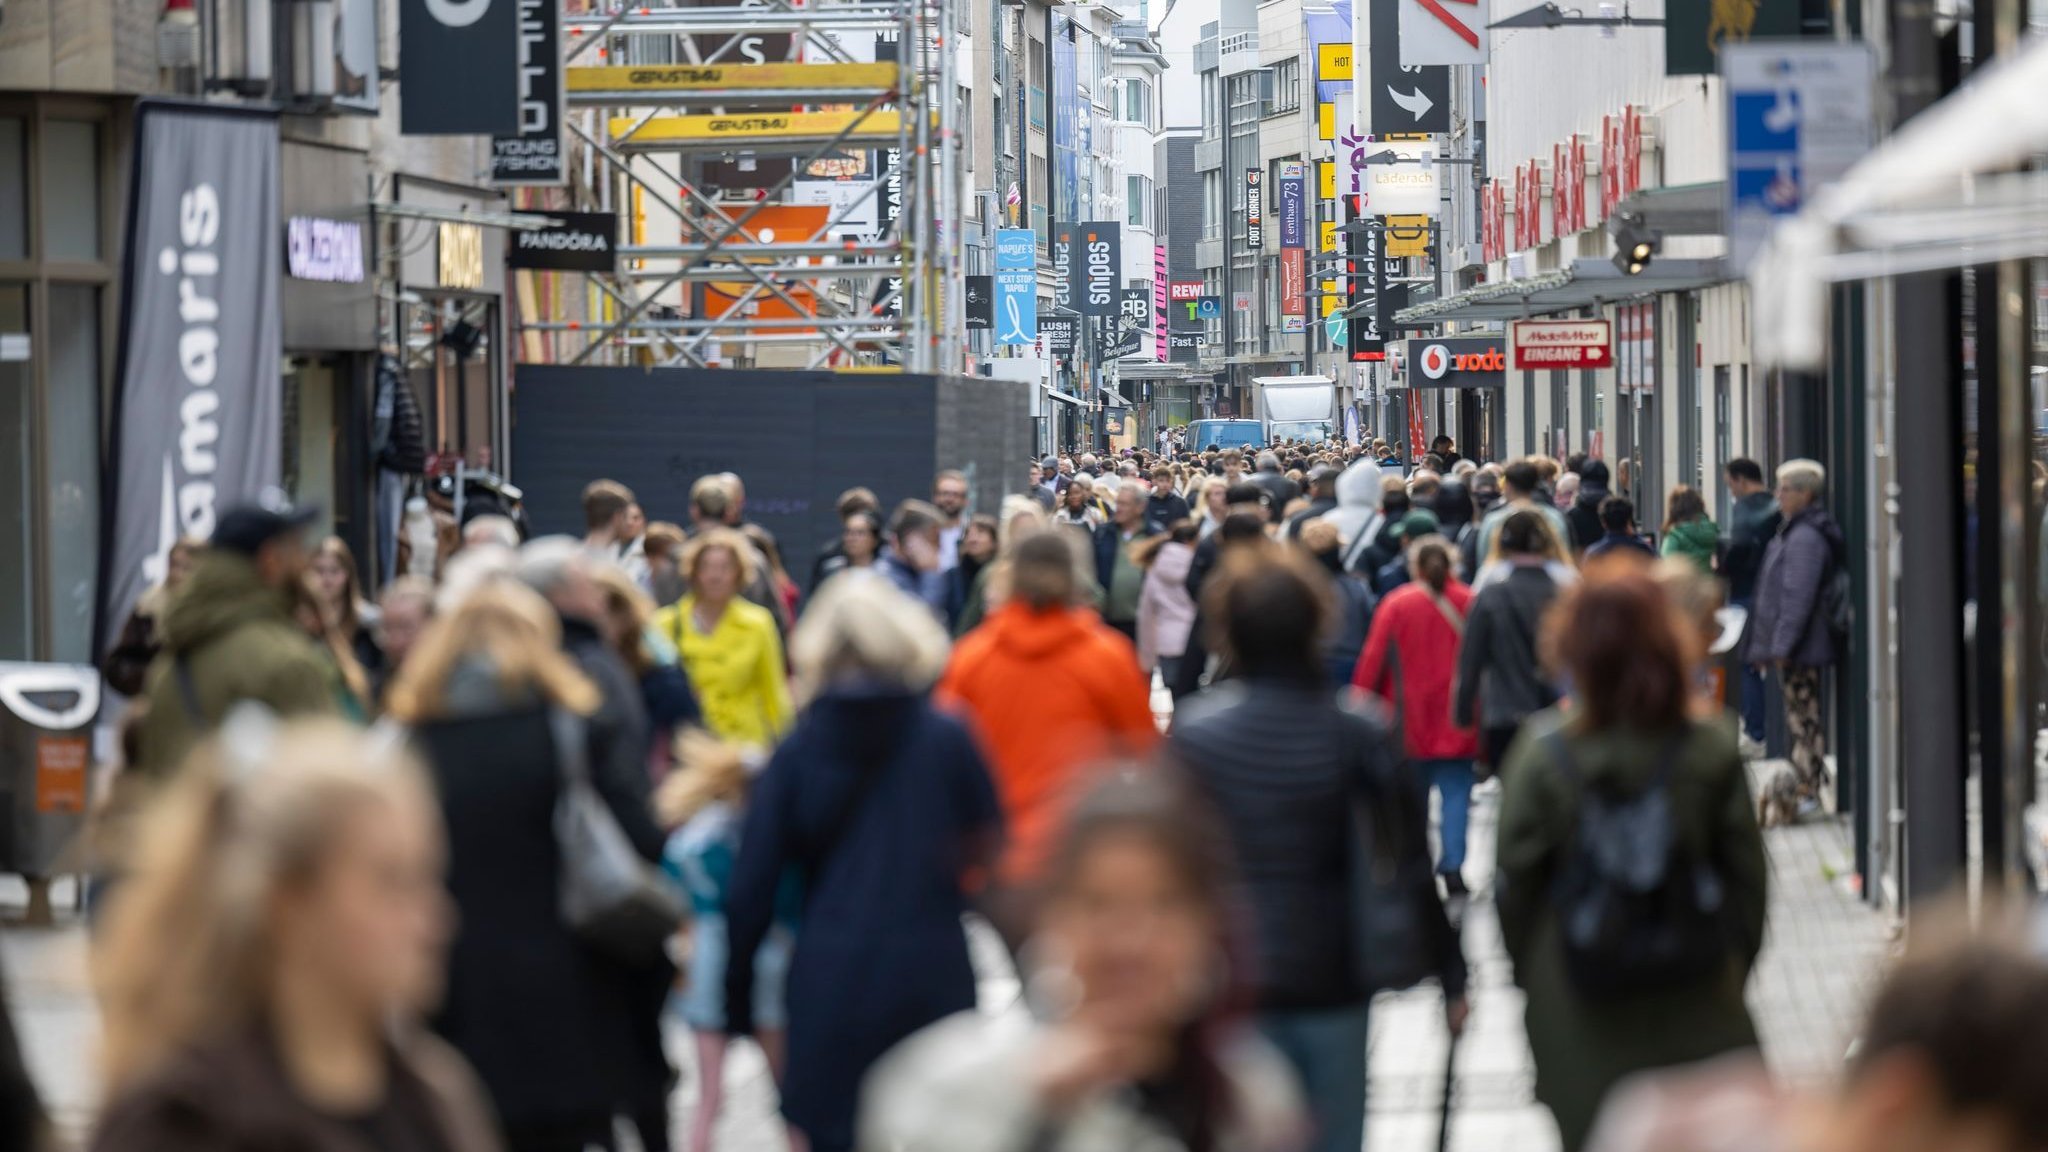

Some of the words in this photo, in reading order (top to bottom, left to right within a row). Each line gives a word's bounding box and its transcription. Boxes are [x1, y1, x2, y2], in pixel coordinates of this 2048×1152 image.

[1334, 57, 1350, 67] HOT
[495, 139, 556, 155] YOUNG
[1375, 172, 1433, 184] Läderach
[1248, 188, 1259, 219] KORNER
[1249, 226, 1260, 246] FOOT
[998, 275, 1015, 283] NEXT
[1089, 241, 1114, 305] snipes
[1040, 322, 1071, 330] LUSH
[1103, 343, 1139, 357] Belgique
[1524, 347, 1582, 362] EINGANG
